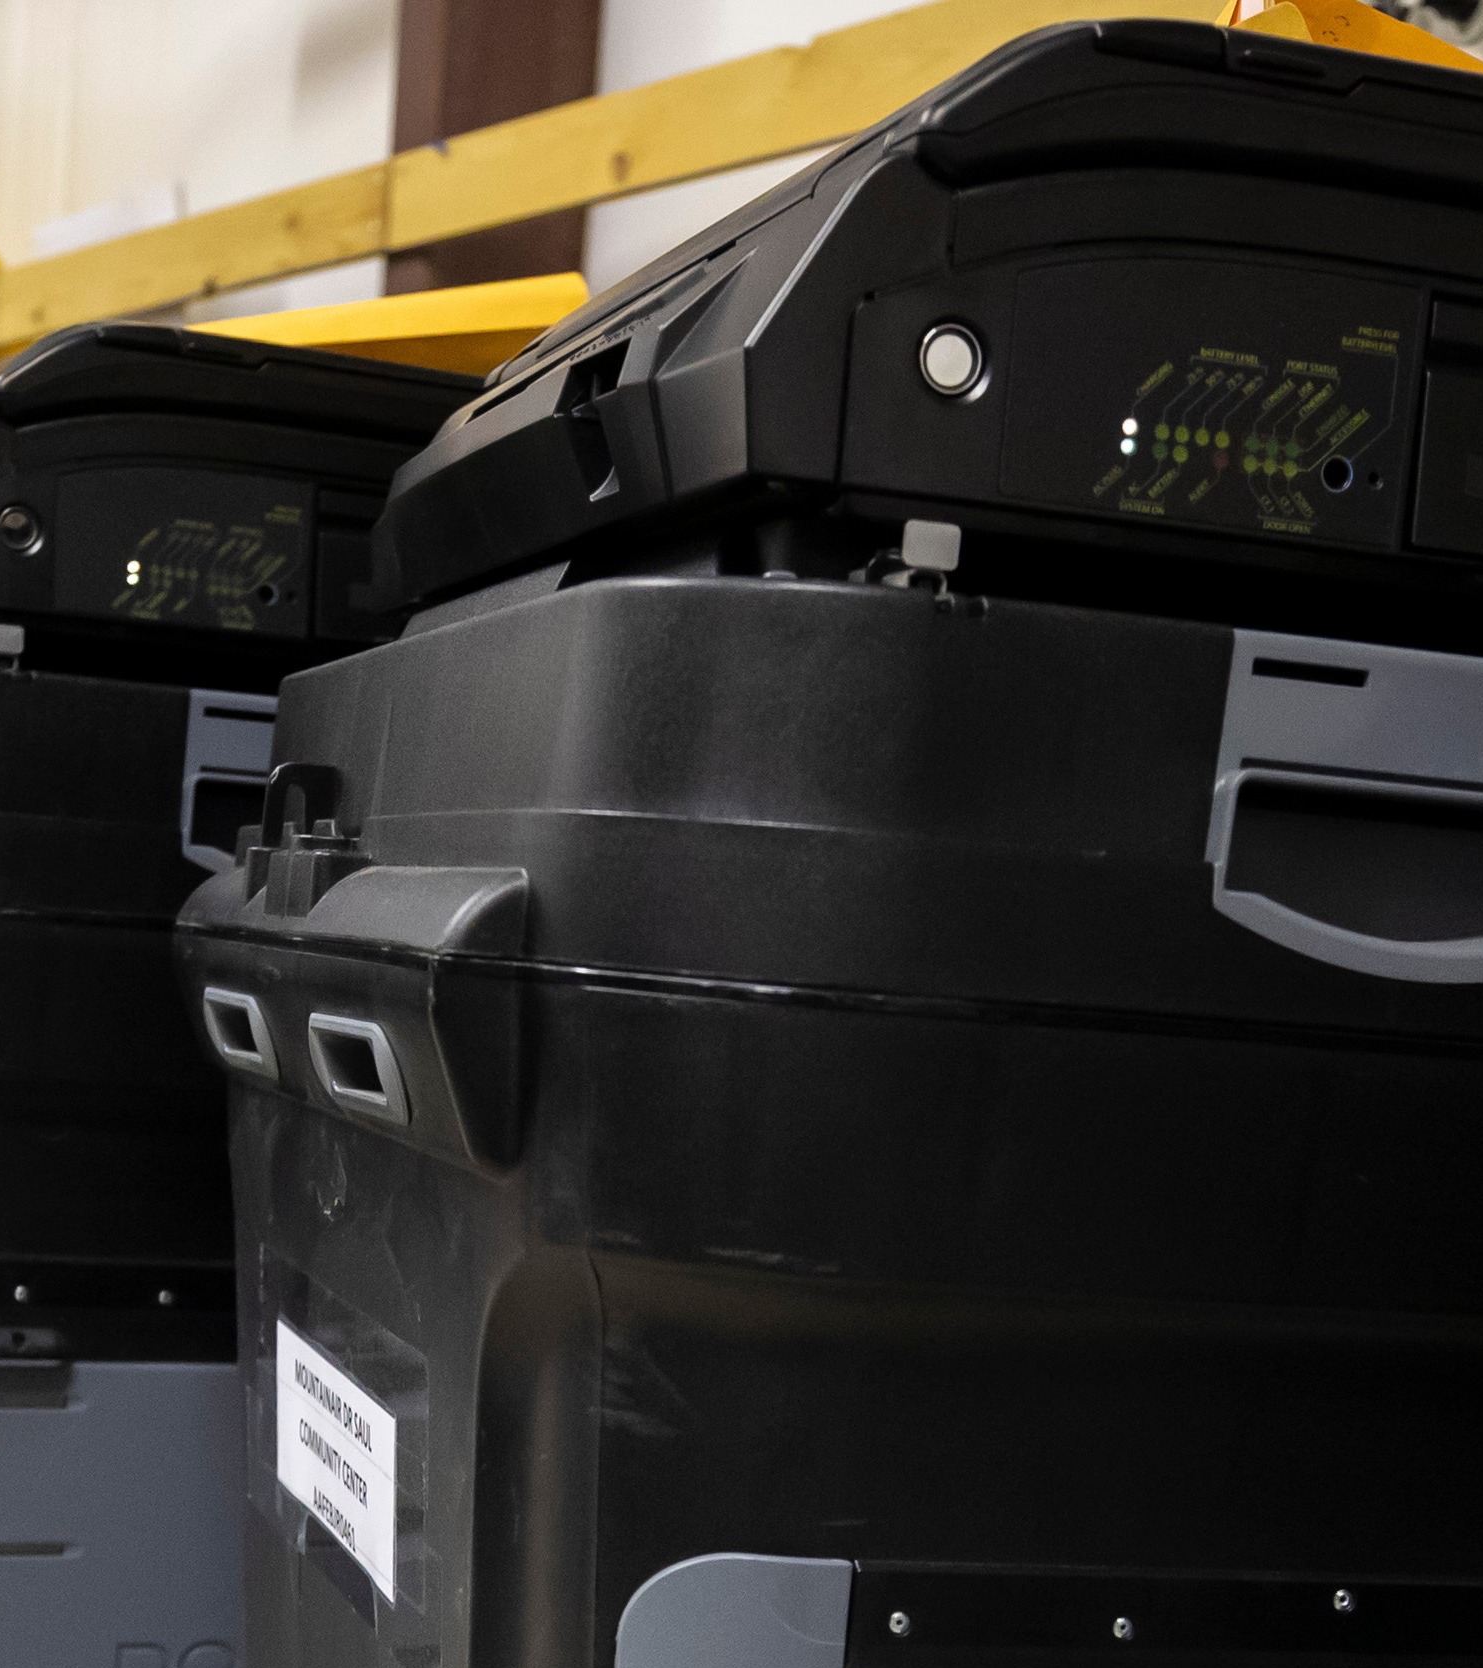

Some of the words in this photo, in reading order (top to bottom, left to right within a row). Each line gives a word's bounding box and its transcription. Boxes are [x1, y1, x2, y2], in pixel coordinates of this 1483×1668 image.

[1358, 325, 1382, 338] PRESS
[1200, 347, 1234, 361] BATTERY
[1236, 351, 1258, 365] LEVEL
[1286, 360, 1307, 372] PORT
[1309, 363, 1338, 377] STATUS
[294, 1359, 342, 1427] MOUNTAINAIR
[354, 1412, 372, 1453] SAUL
[299, 1418, 342, 1480] COMMUNITY
[343, 1460, 368, 1509] CENTER
